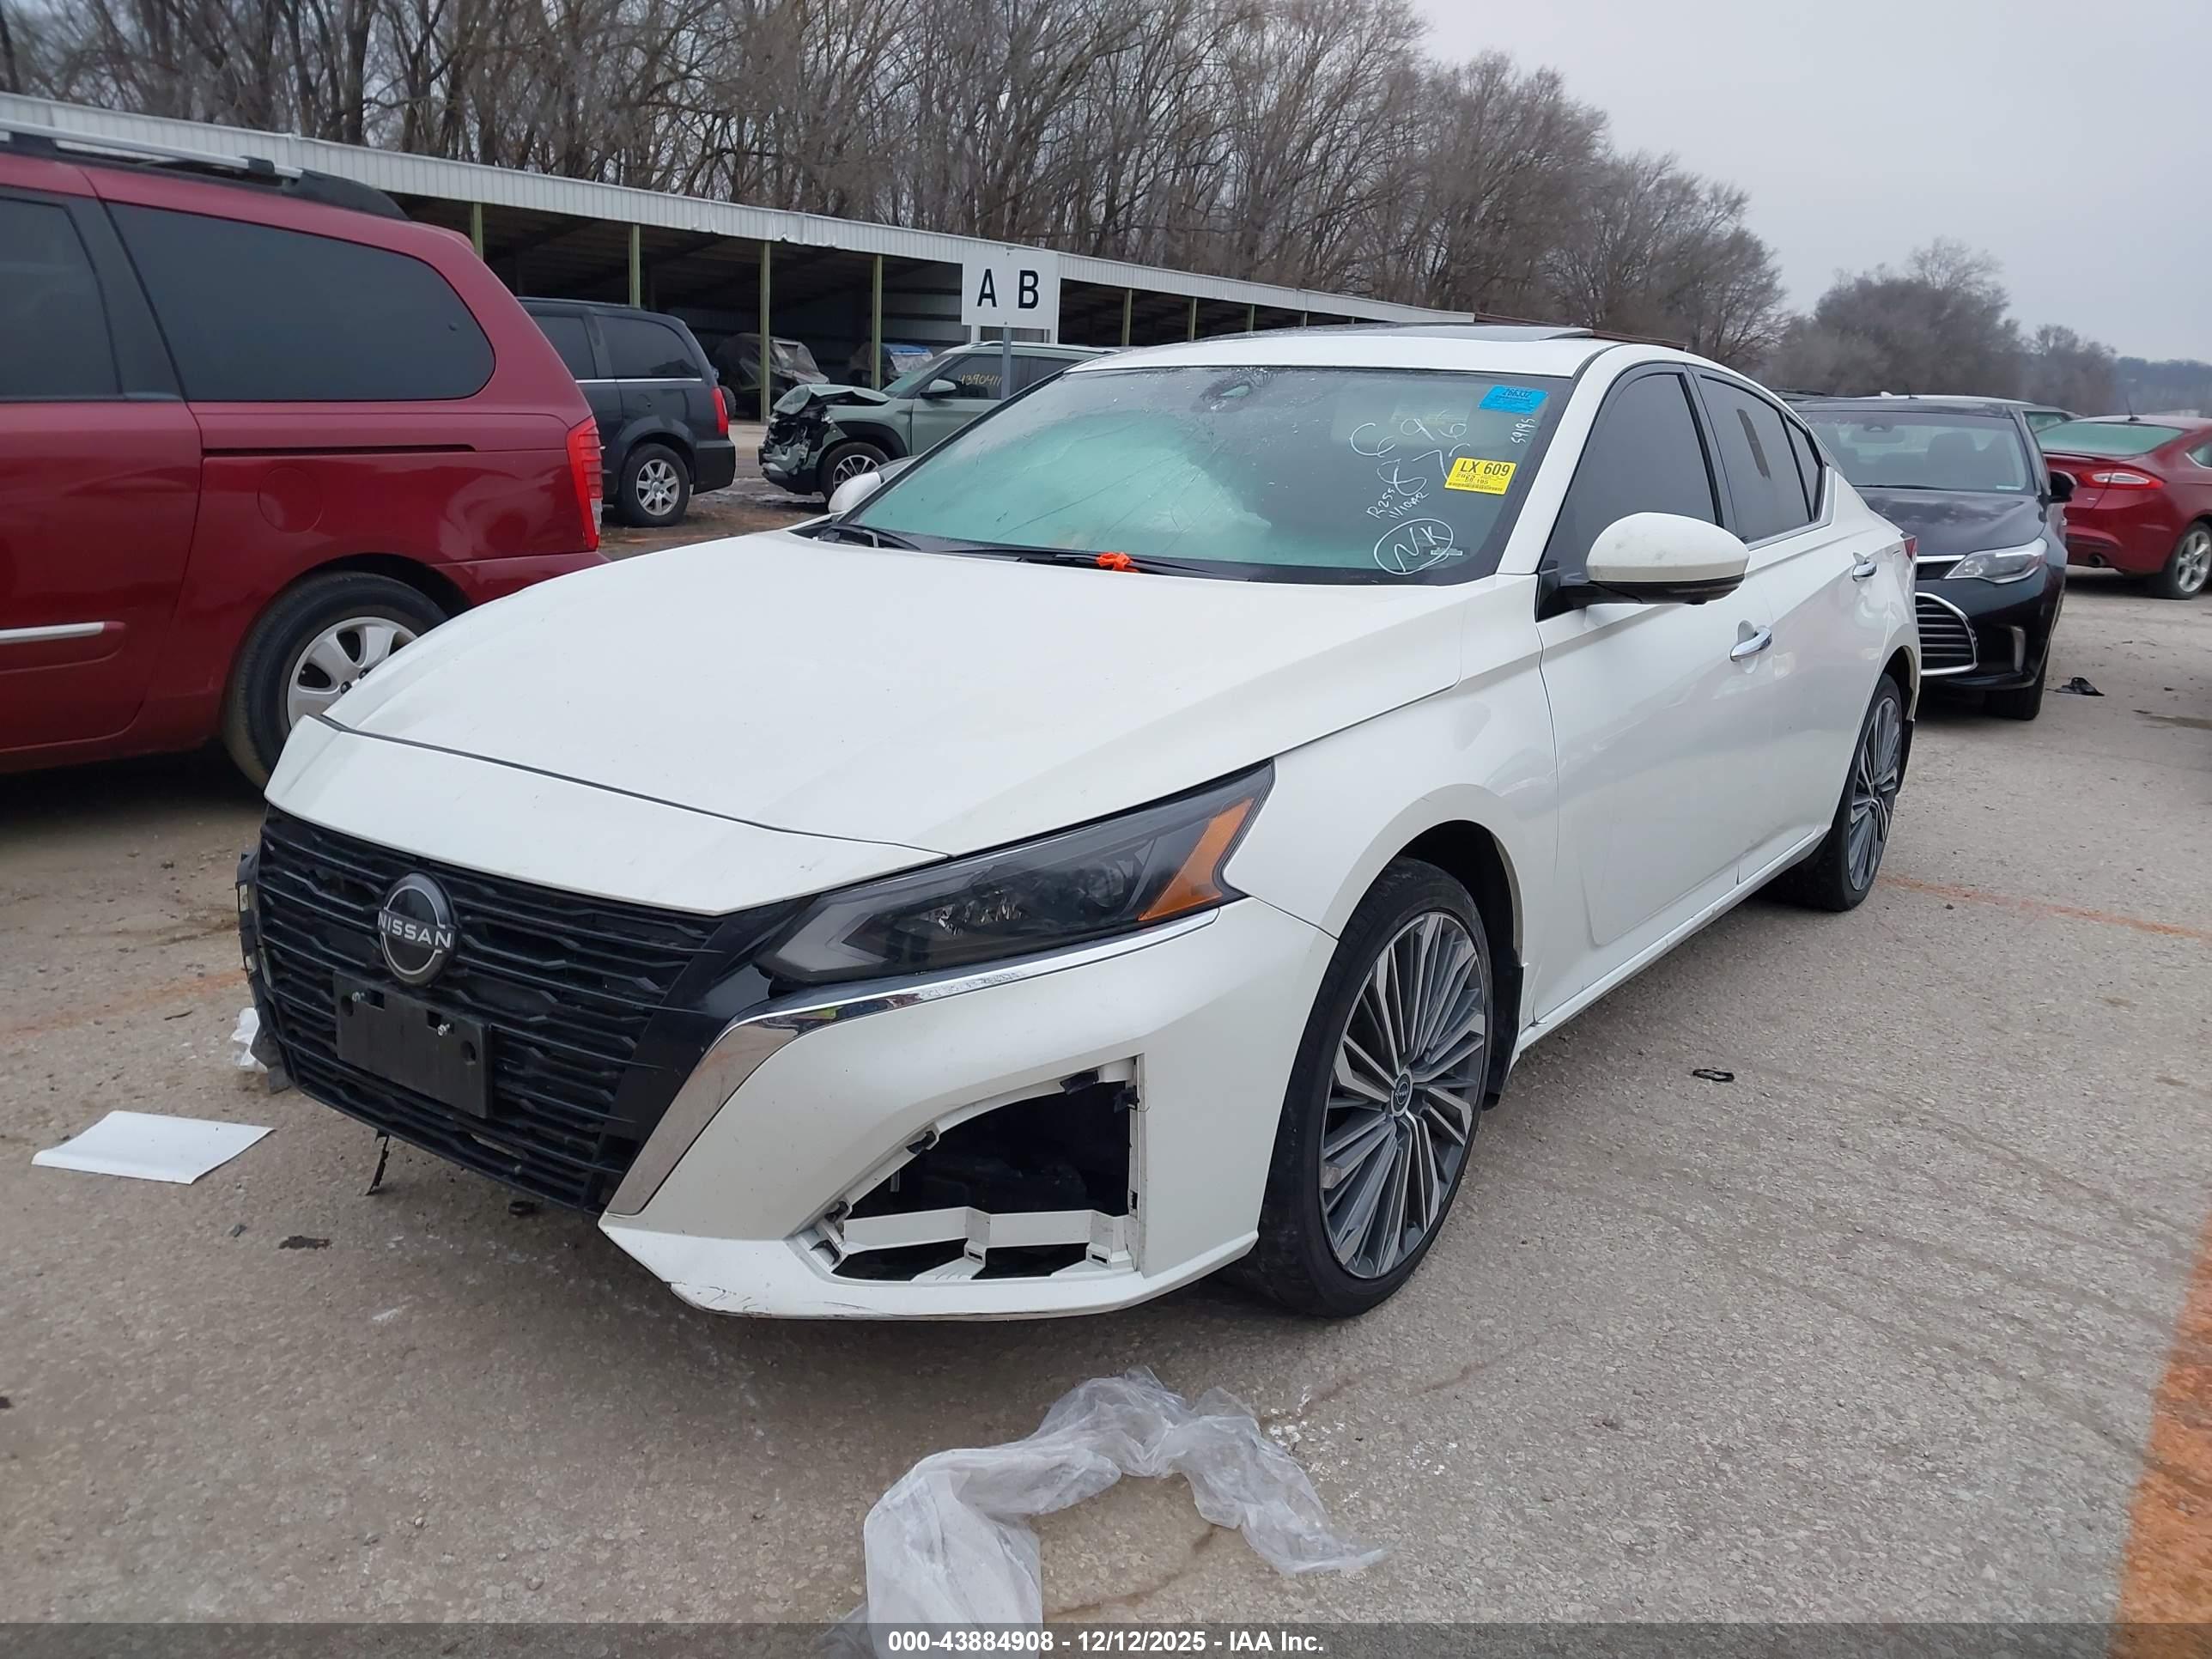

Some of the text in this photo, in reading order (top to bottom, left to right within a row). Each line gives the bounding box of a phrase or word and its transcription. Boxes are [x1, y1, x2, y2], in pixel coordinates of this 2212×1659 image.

[976, 268, 1040, 309] A B
[1460, 460, 1480, 474] LX
[1483, 462, 1511, 477] 609
[377, 910, 453, 949] NISSAN
